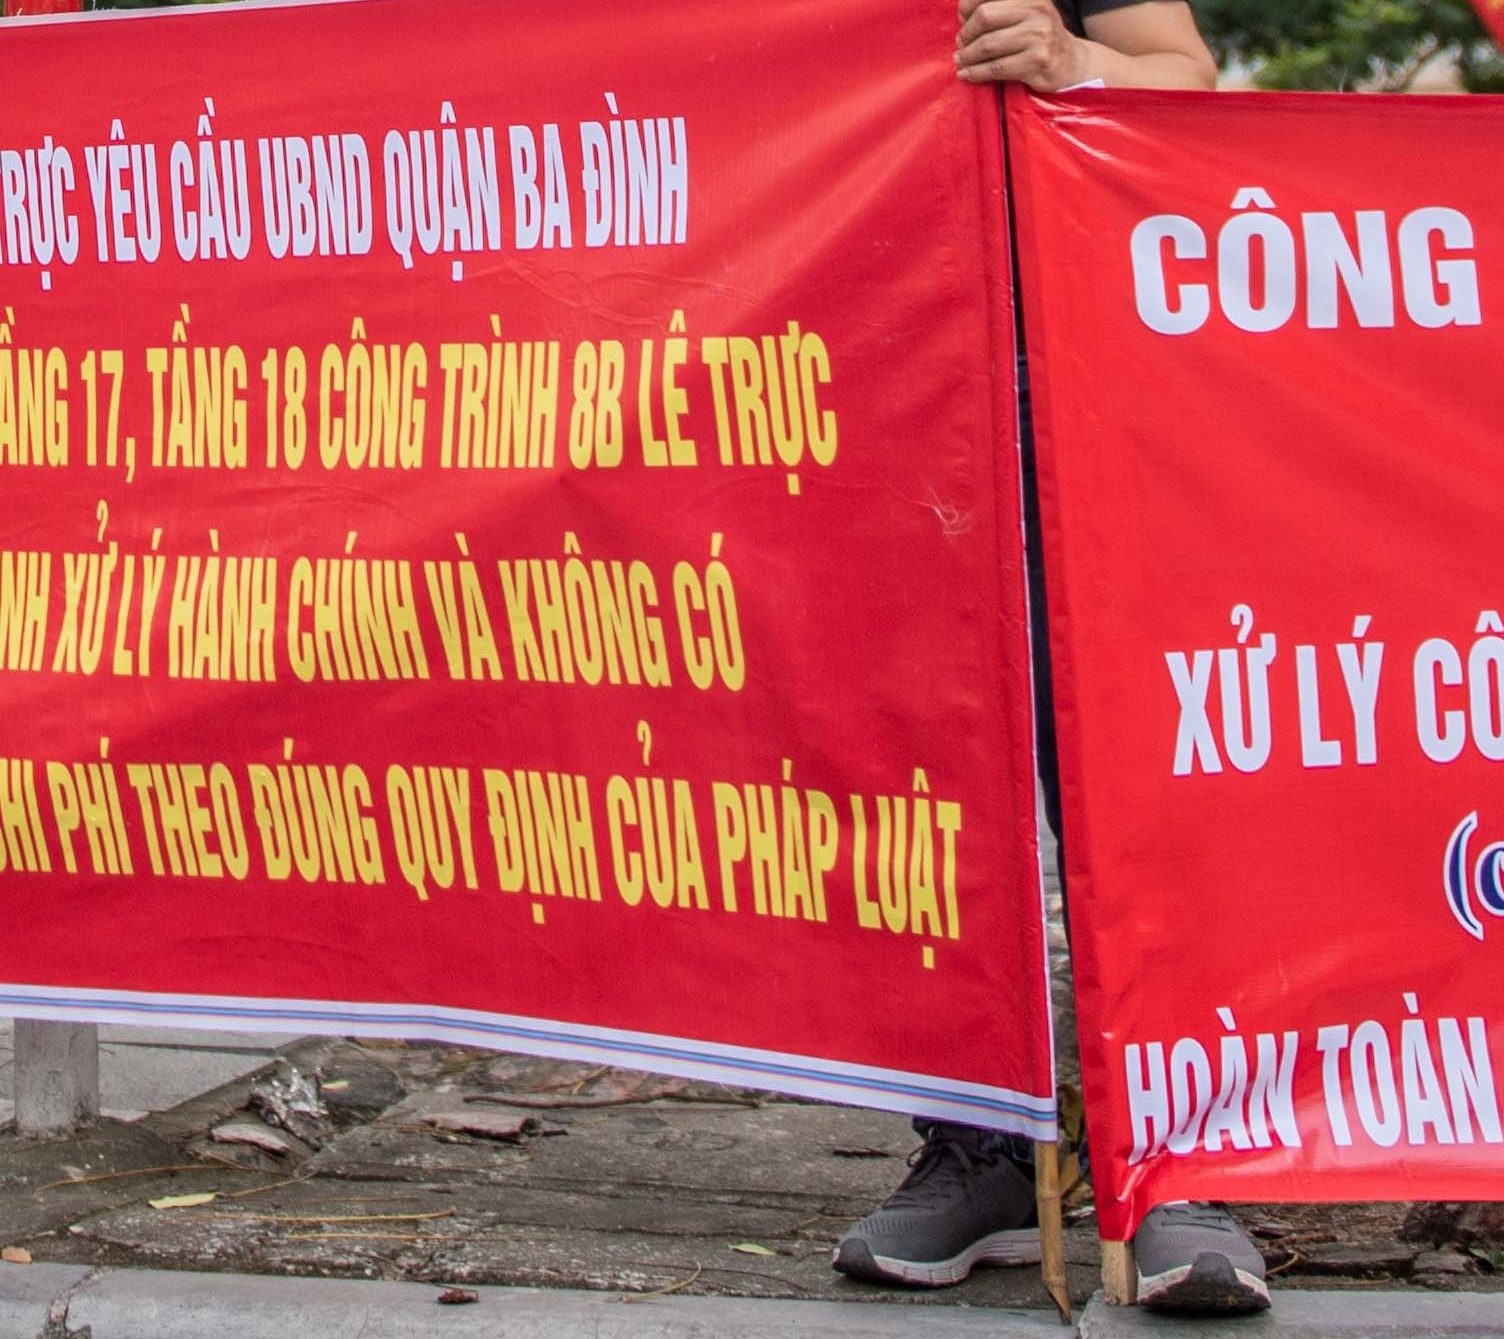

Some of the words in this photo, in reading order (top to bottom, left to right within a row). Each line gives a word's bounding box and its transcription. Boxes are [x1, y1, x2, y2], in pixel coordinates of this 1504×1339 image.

[85, 119, 161, 262] YÊU
[171, 98, 250, 261] CẦU
[259, 134, 372, 258] UBND
[384, 102, 500, 280] QUẬN
[509, 124, 572, 249] BA
[580, 93, 687, 246] ĐÌNH
[1130, 187, 1481, 334] CÔNG
[81, 351, 135, 482] 17,
[147, 304, 247, 469] TẦNG
[262, 347, 306, 469] 18
[320, 318, 427, 469] CÔNG
[441, 315, 559, 468] TRÌNH
[569, 340, 624, 469] 8B
[639, 310, 697, 466] LÊ
[702, 321, 837, 494] TRỰC
[52, 500, 117, 675] XỬ
[113, 528, 165, 676] LÝ
[169, 529, 276, 681] HÀNH
[288, 531, 429, 681] CHÍNH
[424, 533, 502, 679] VÀ
[499, 532, 671, 686] KHÔNG
[674, 533, 744, 690] CÓ
[1165, 604, 1276, 775] XỬ
[1296, 616, 1383, 766] LÝ
[47, 737, 132, 874] PHÍ
[127, 763, 248, 879] THEO
[248, 739, 384, 884] ĐÚNG
[387, 765, 477, 900] QUY
[484, 770, 601, 923] ĐỊNH
[607, 721, 708, 909] CỦA
[713, 760, 838, 921] PHÁP
[851, 769, 961, 968] LUẬT
[1126, 1007, 1302, 1171] HOÀN
[1317, 993, 1504, 1154] TOÀN
